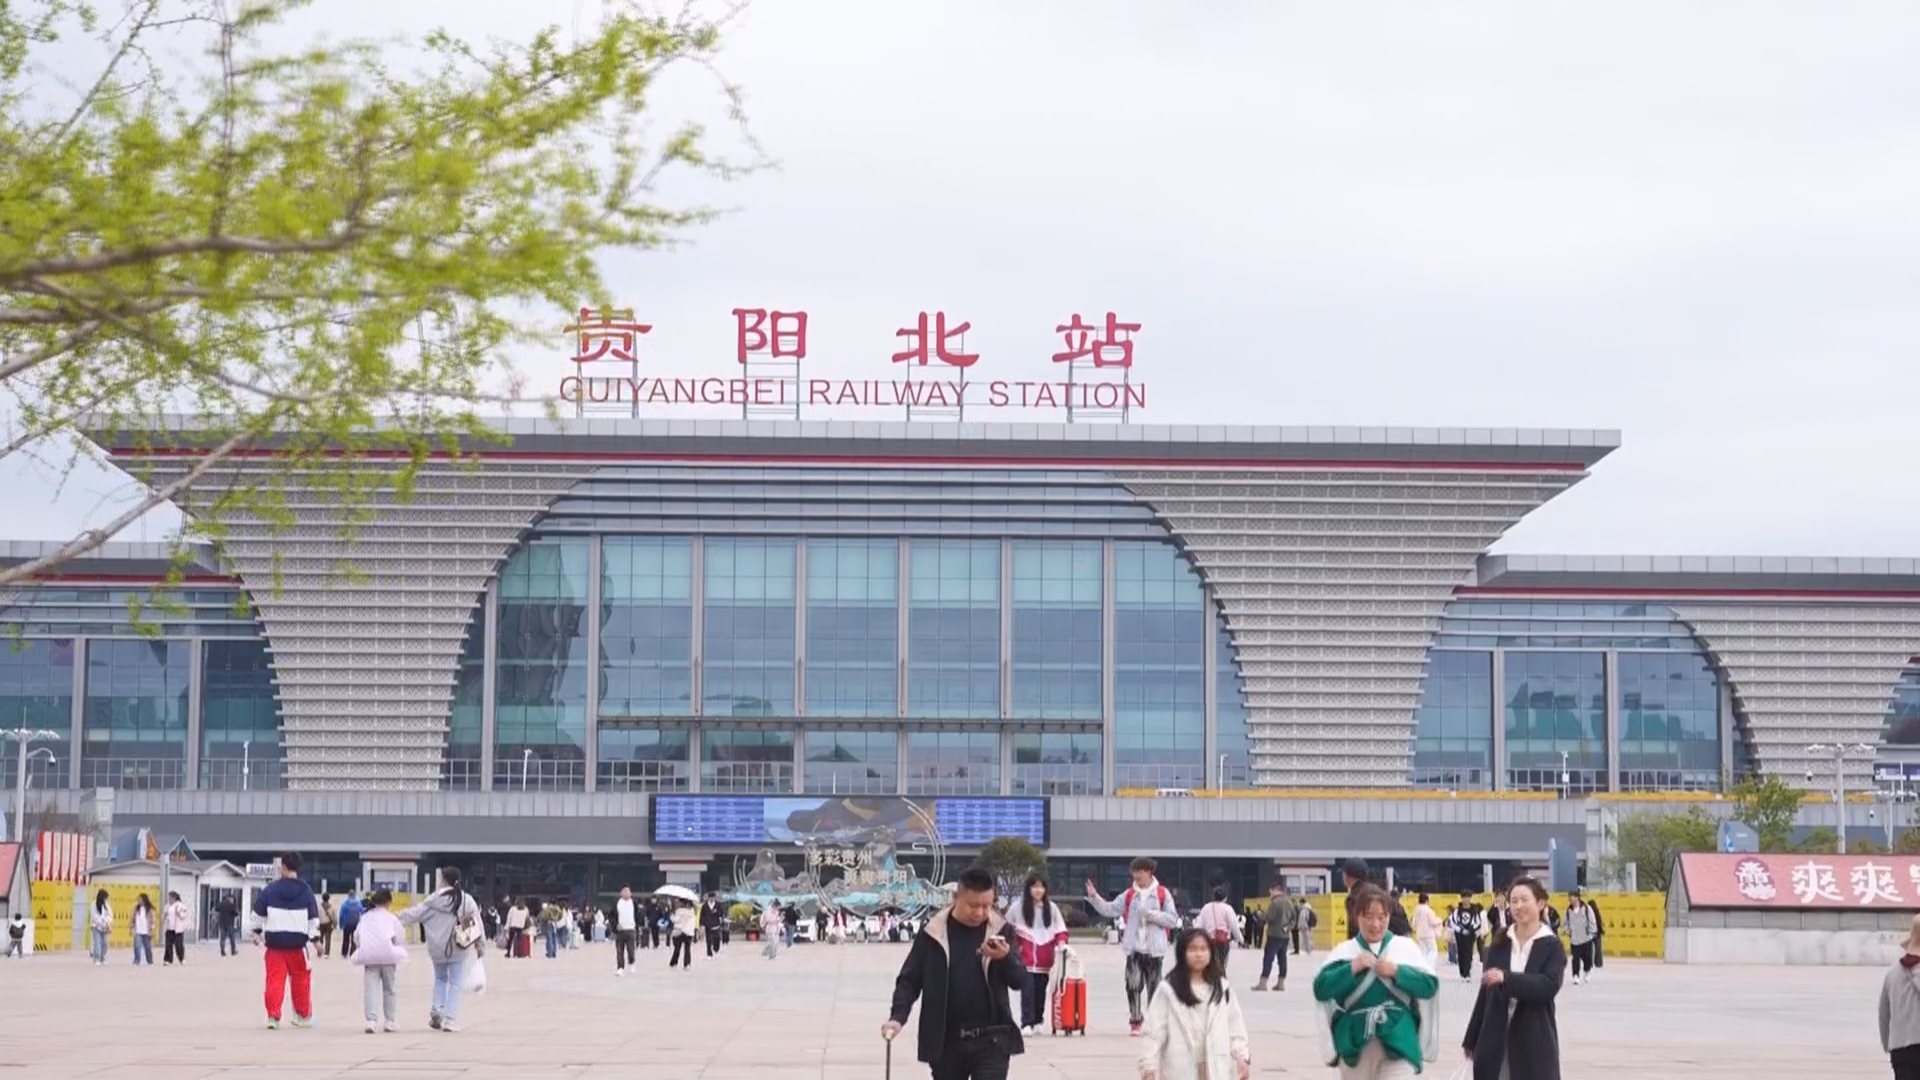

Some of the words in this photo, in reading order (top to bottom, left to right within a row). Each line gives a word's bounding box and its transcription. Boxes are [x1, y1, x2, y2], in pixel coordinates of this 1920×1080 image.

[563, 304, 1142, 368] 贵阳北站
[560, 376, 785, 405] GUIYANGBEI
[809, 379, 970, 407] RAILWAY
[989, 381, 1146, 409] STATION
[810, 849, 872, 866] 多彩贵州
[1791, 860, 1920, 904] 爽爽
